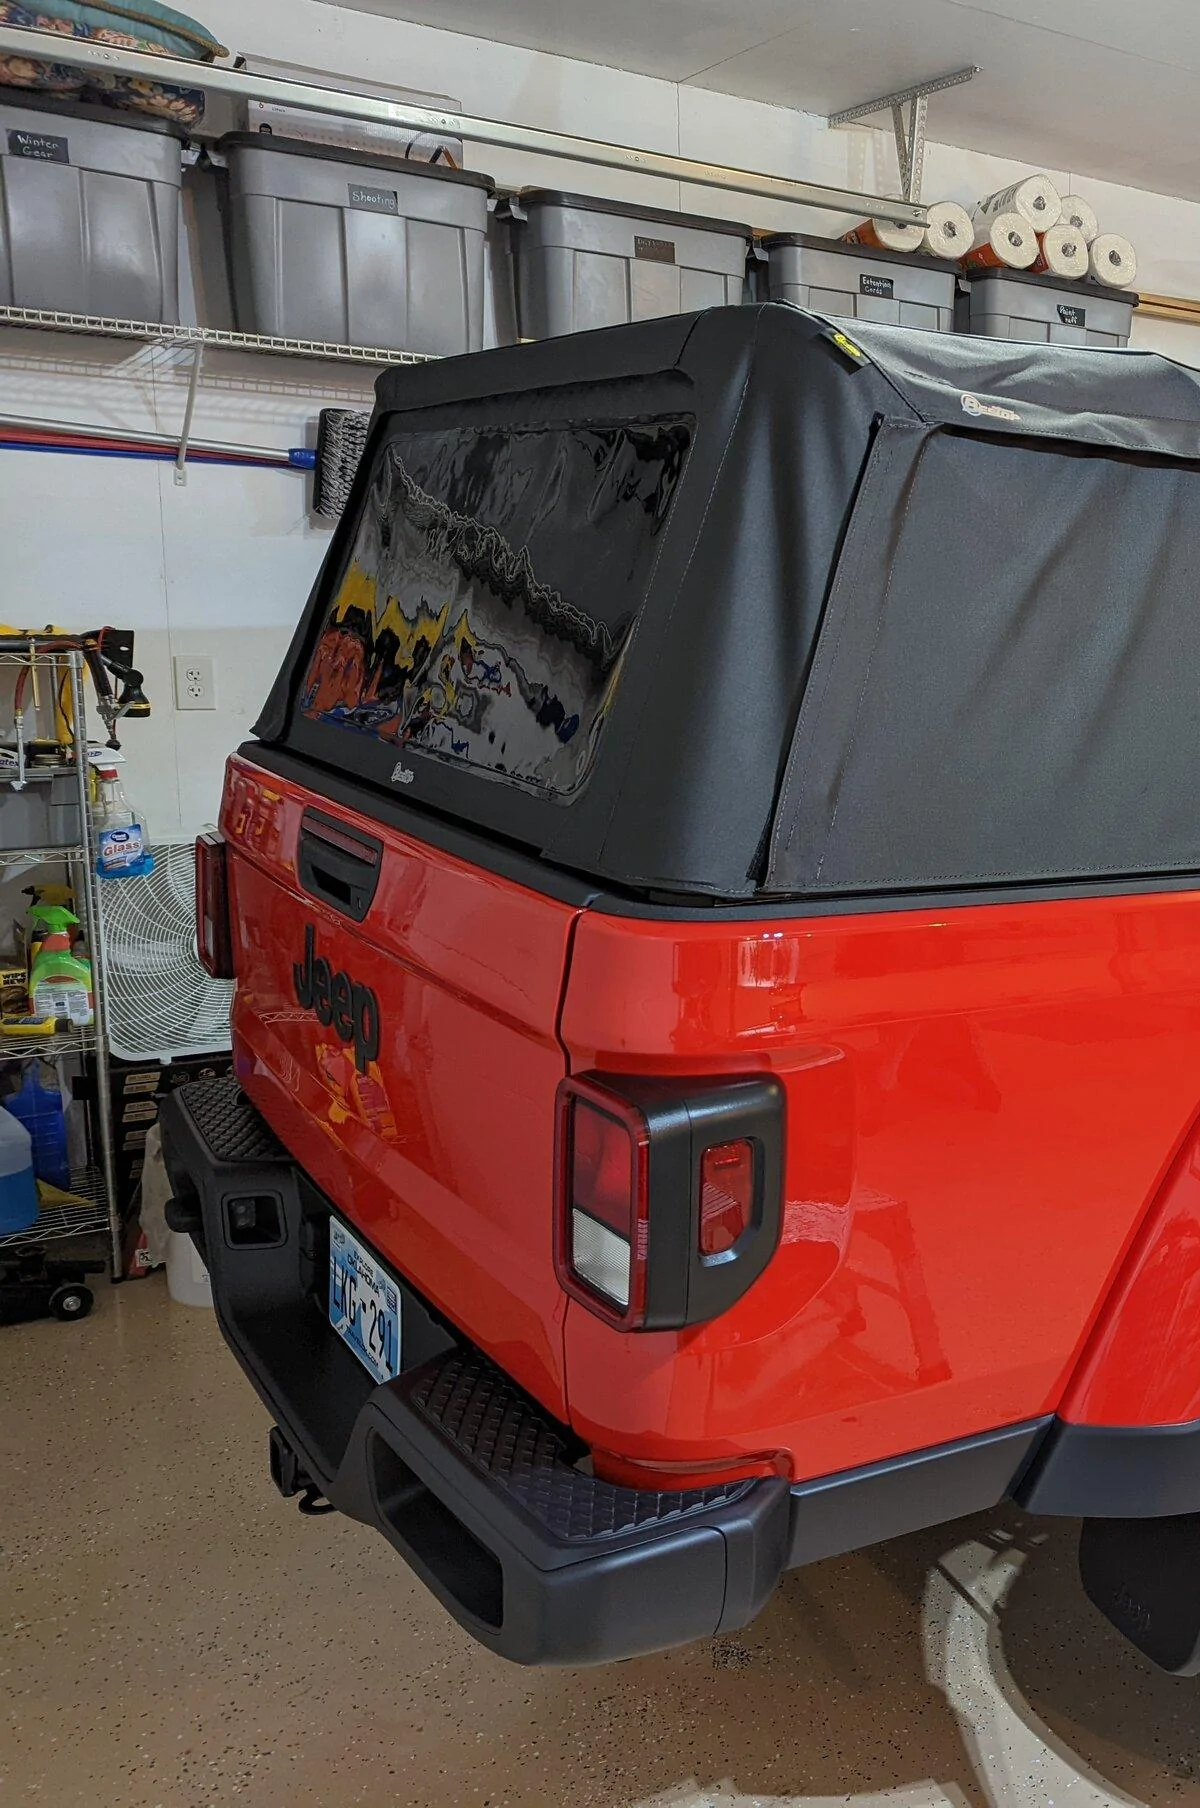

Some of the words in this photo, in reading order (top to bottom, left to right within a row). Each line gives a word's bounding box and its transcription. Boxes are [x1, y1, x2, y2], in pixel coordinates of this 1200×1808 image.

[16, 134, 60, 149] Winter
[22, 145, 54, 158] Gear
[352, 190, 395, 210] Shooting
[103, 841, 140, 857] Glass
[293, 922, 380, 1076] Jeep
[347, 1253, 381, 1298] OKLAHOMA
[333, 1256, 393, 1375] LKG-291
